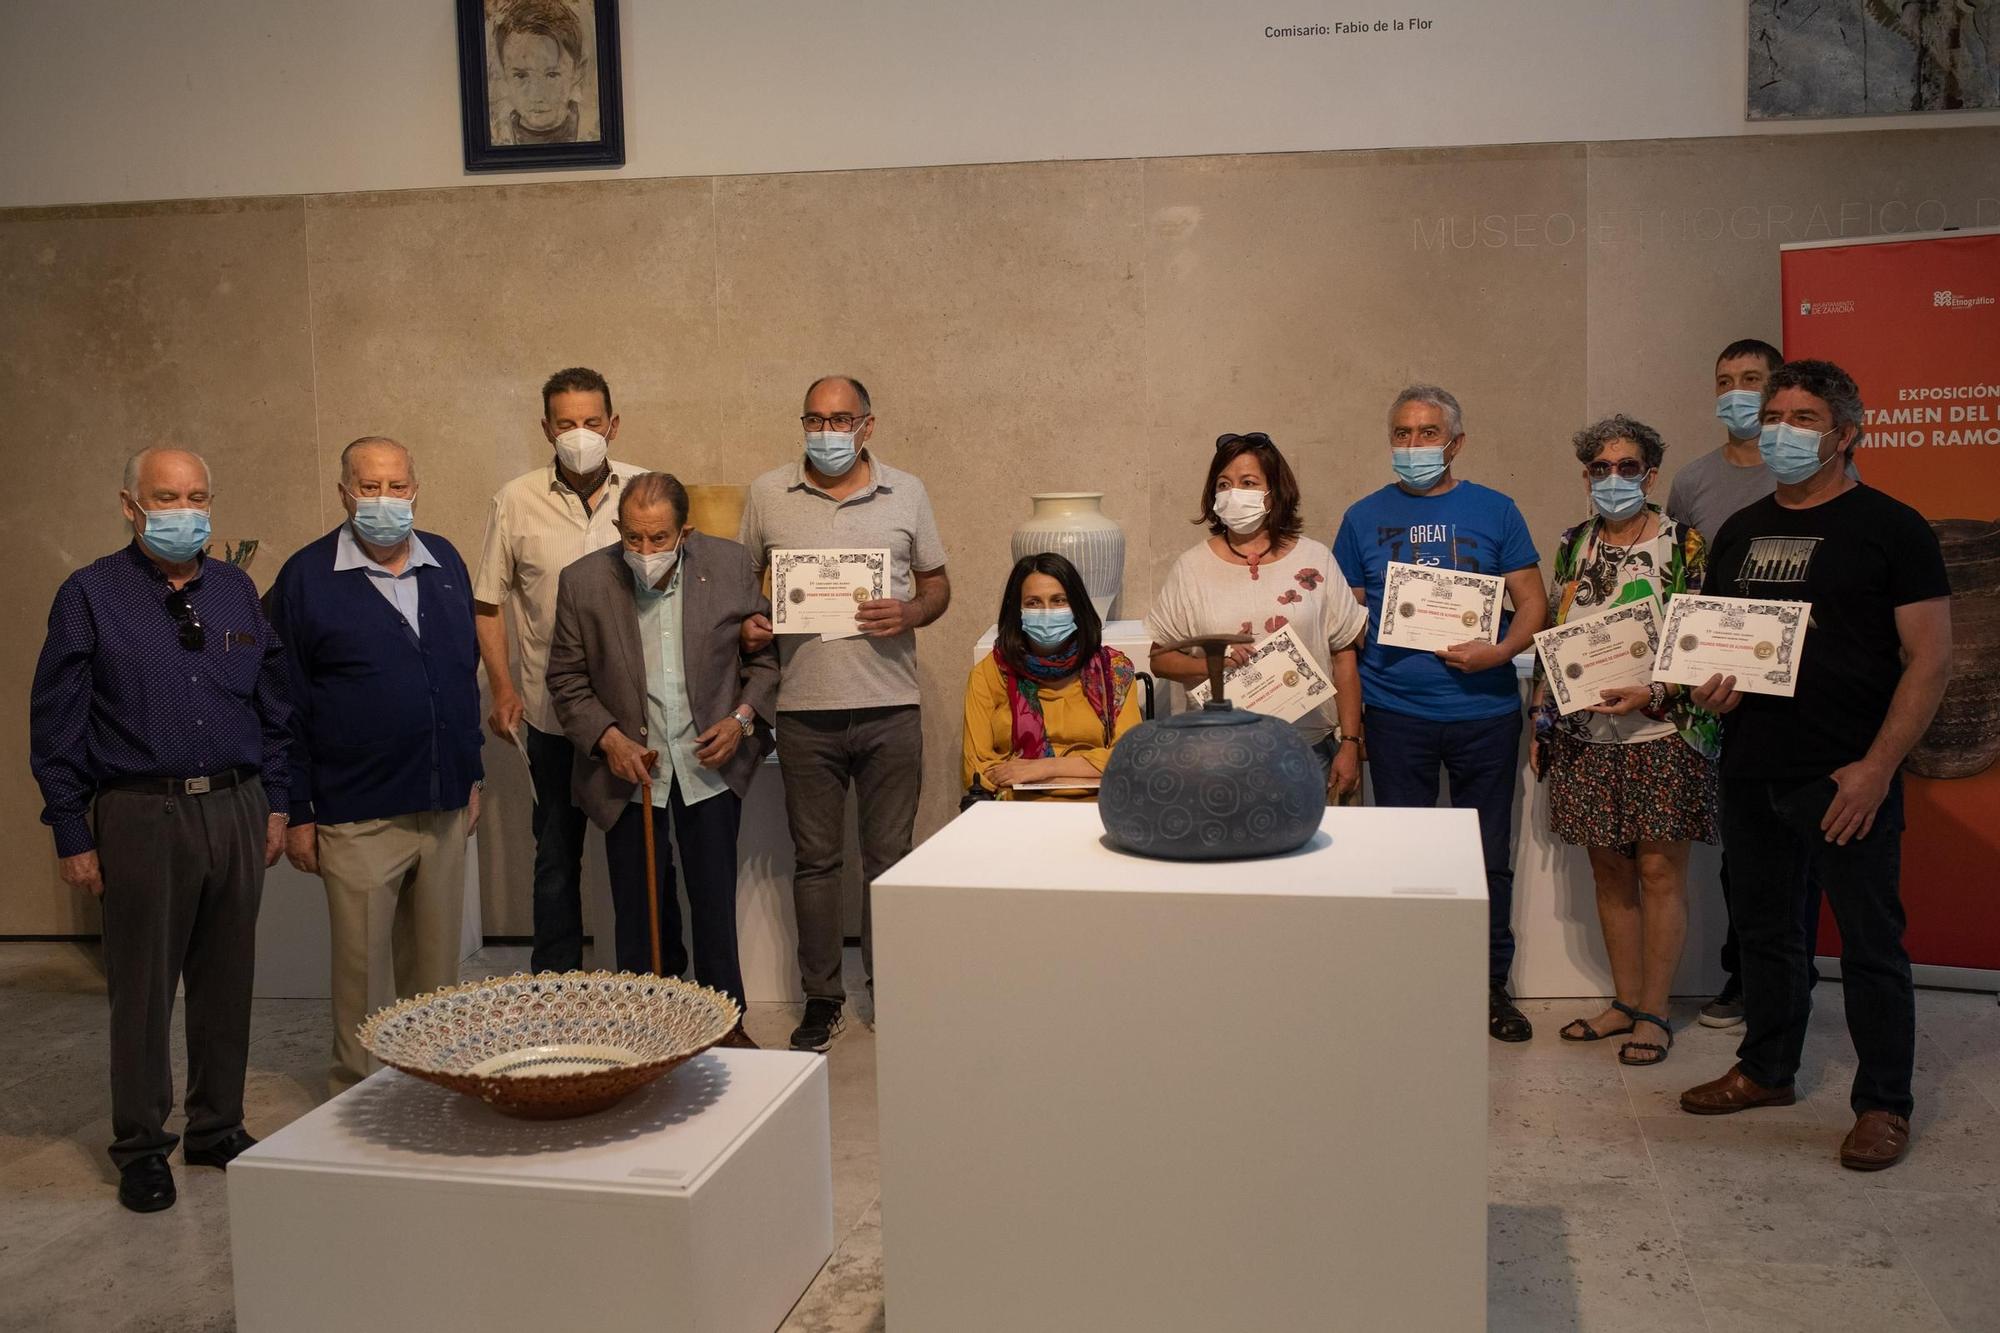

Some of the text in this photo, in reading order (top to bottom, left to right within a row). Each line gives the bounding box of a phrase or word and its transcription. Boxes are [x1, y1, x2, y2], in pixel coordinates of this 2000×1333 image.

[1264, 18, 1433, 38] Comisario: Fabio de la Flor
[1413, 212, 1576, 251] MUSEO
[1951, 296, 1995, 307] Etnográfico
[1899, 383, 2000, 401] EXPOSICIÓN
[1860, 405, 1990, 426] TAMEN DEL
[1410, 524, 1447, 544] GREAT
